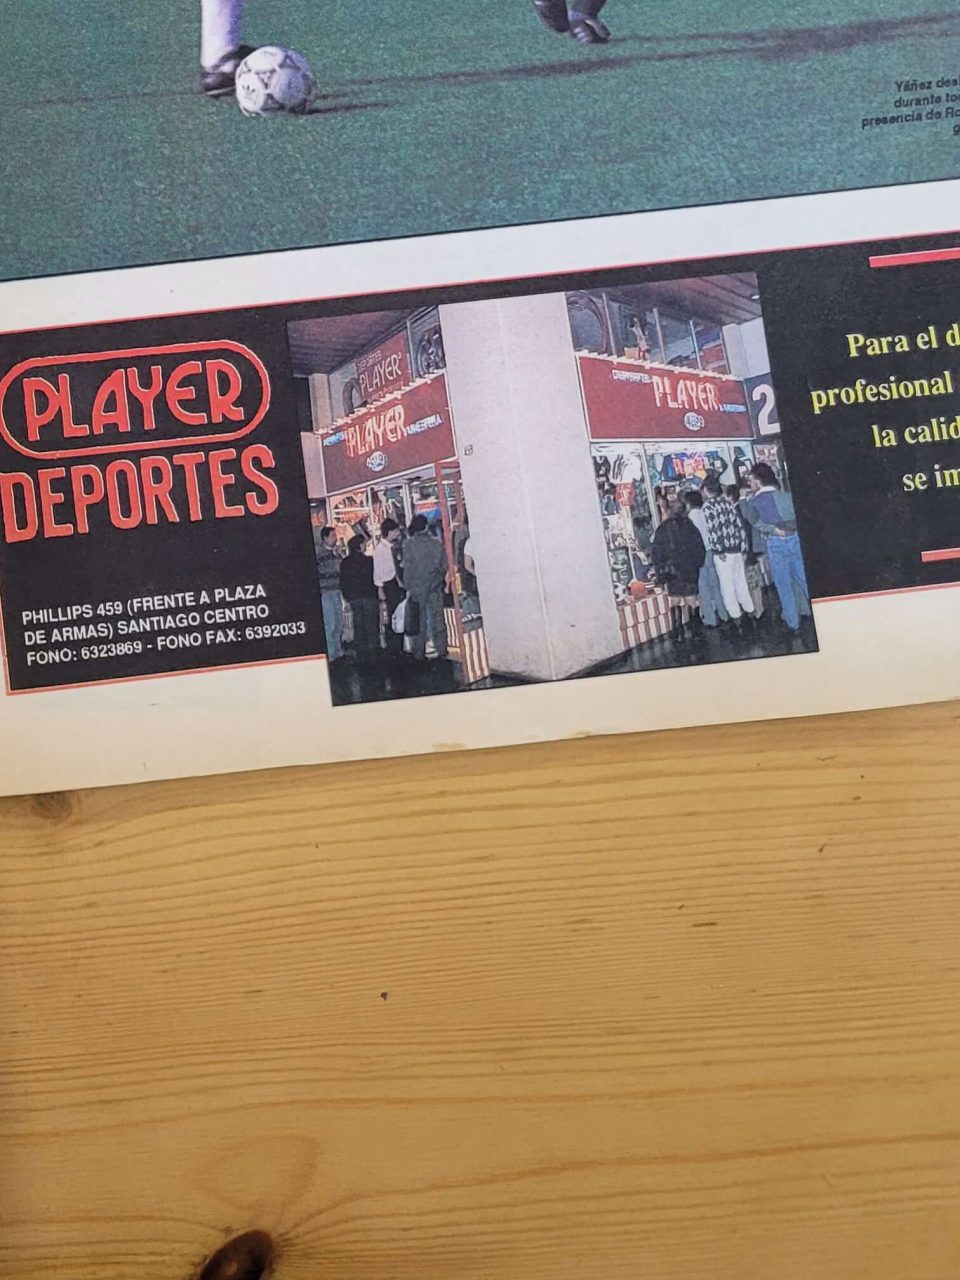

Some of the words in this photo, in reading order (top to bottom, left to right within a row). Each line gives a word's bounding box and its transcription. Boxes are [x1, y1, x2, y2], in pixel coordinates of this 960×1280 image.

[862, 111, 922, 130] presencia
[845, 333, 911, 358] Para
[916, 325, 939, 350] el
[23, 359, 244, 441] PLAYER
[651, 376, 722, 412] PLAYER
[752, 384, 782, 437] 2
[810, 370, 954, 415] profesional
[871, 424, 898, 448] la
[0, 444, 279, 543] DEPORTES
[902, 472, 928, 492] se
[21, 604, 94, 626] PHILLIPS
[96, 600, 123, 617] 459
[126, 591, 196, 617] (FRENTE
[199, 590, 211, 605] A
[214, 583, 267, 603] PLAZA
[23, 629, 47, 646] DE
[51, 622, 114, 643] ARMAS)
[117, 611, 201, 635] SANTIAGO
[203, 603, 269, 624] CENTRO
[26, 647, 78, 667] FONO:
[80, 640, 143, 660] 6323869
[156, 632, 202, 651] FONO
[205, 627, 242, 645] FAX:
[245, 620, 306, 640] 6392033
